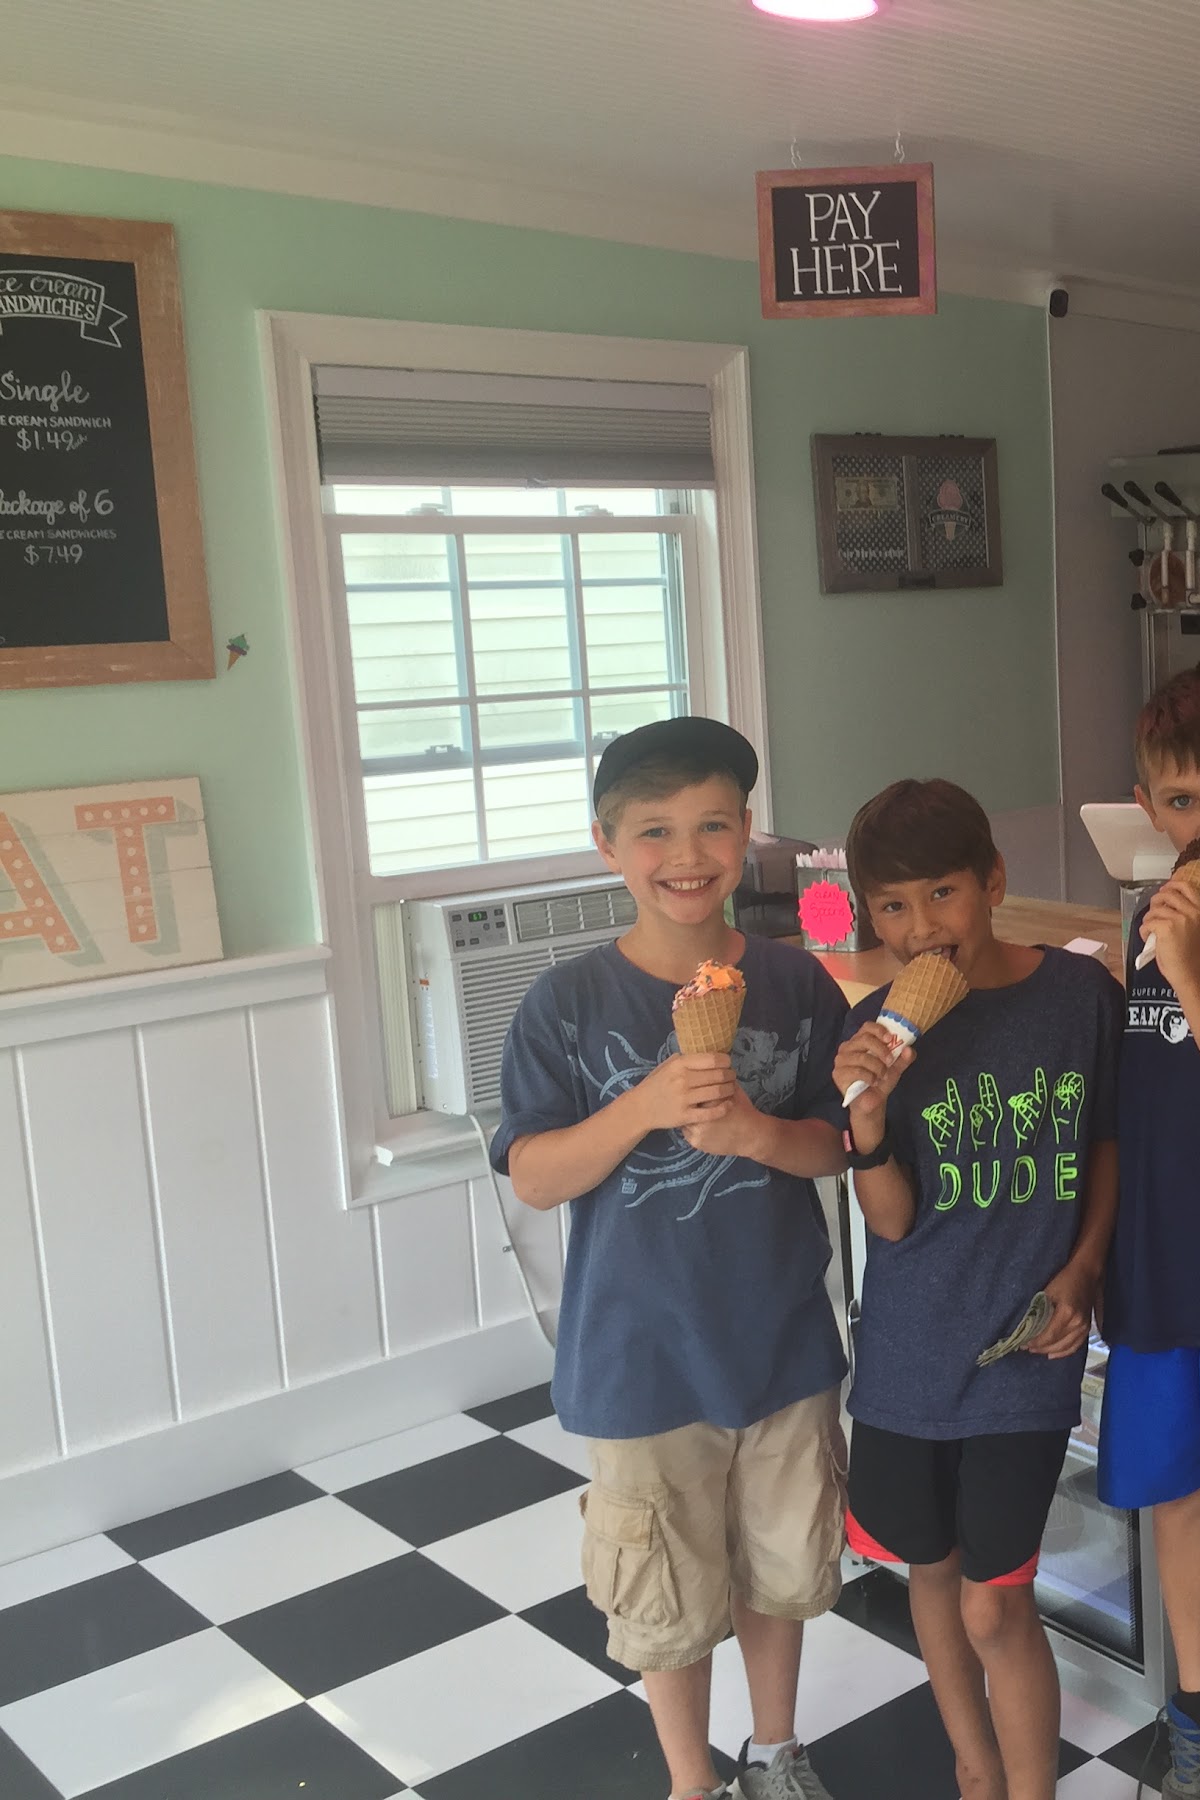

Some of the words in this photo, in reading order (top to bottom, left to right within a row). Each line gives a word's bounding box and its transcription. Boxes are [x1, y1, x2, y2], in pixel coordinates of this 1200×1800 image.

[805, 190, 882, 242] PAY
[789, 239, 903, 295] HERE
[0, 369, 90, 412] Single
[8, 414, 49, 428] CREAM
[48, 415, 113, 429] SANDWICH
[15, 427, 74, 452] $1.49
[68, 488, 91, 524] of
[93, 488, 115, 516] 6
[5, 529, 46, 541] CREAM
[46, 528, 118, 540] SANDWICHES
[23, 543, 84, 566] $7.49
[1131, 987, 1157, 998] SUPER
[934, 1151, 1079, 1212] DUDE
